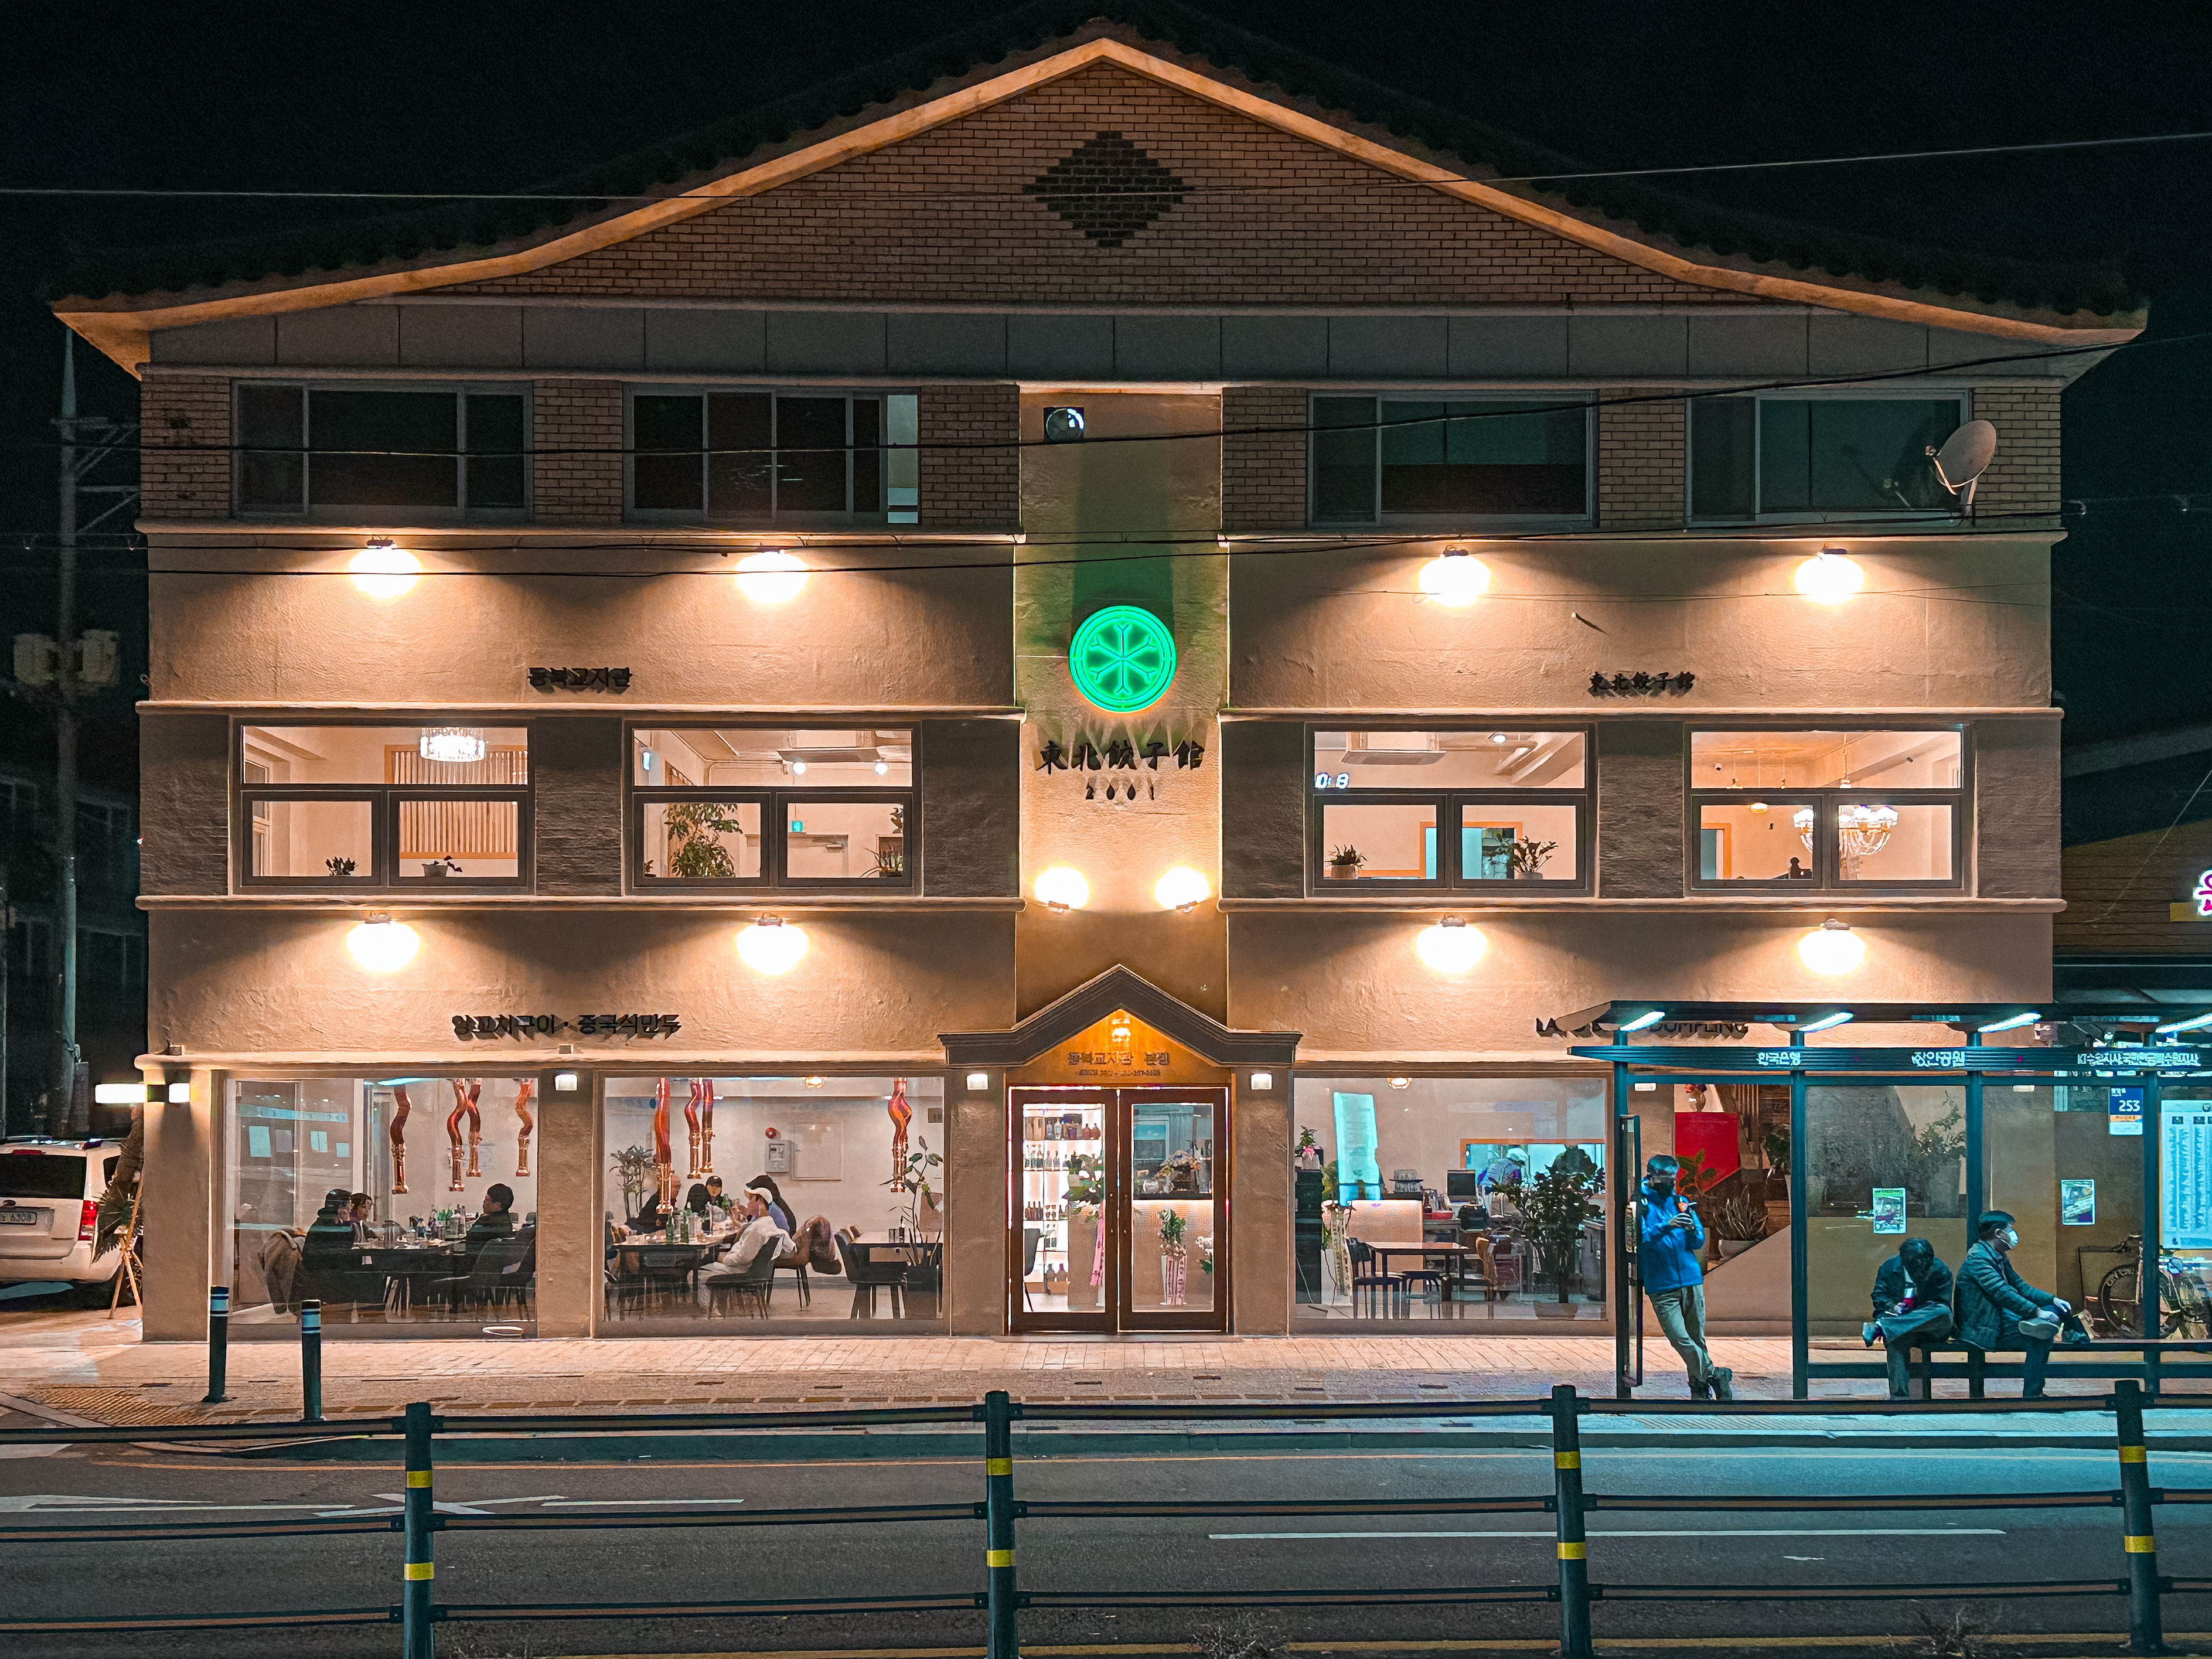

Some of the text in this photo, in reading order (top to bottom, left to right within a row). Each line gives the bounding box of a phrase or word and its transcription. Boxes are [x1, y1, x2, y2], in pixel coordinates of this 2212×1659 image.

[527, 666, 633, 687] 동북교자관
[1085, 782, 1154, 800] 2001
[578, 1014, 682, 1035] 중국식만두
[2118, 1099, 2141, 1112] 253
